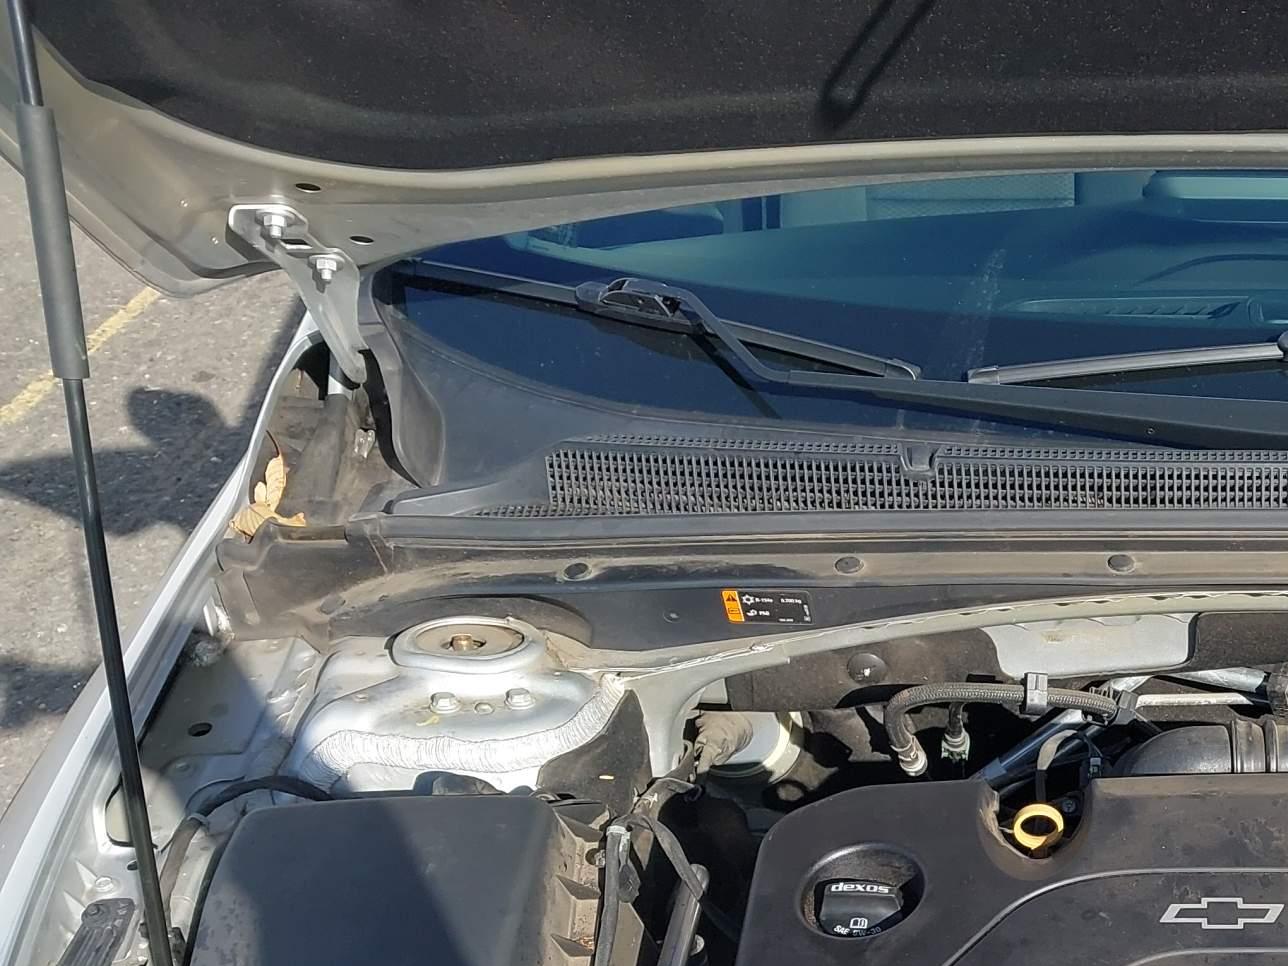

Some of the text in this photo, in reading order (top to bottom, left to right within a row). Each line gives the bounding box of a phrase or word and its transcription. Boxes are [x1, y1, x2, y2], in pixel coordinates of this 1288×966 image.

[831, 882, 889, 894] dexos
[833, 924, 850, 935] SAE
[852, 926, 882, 937] 5W-30
